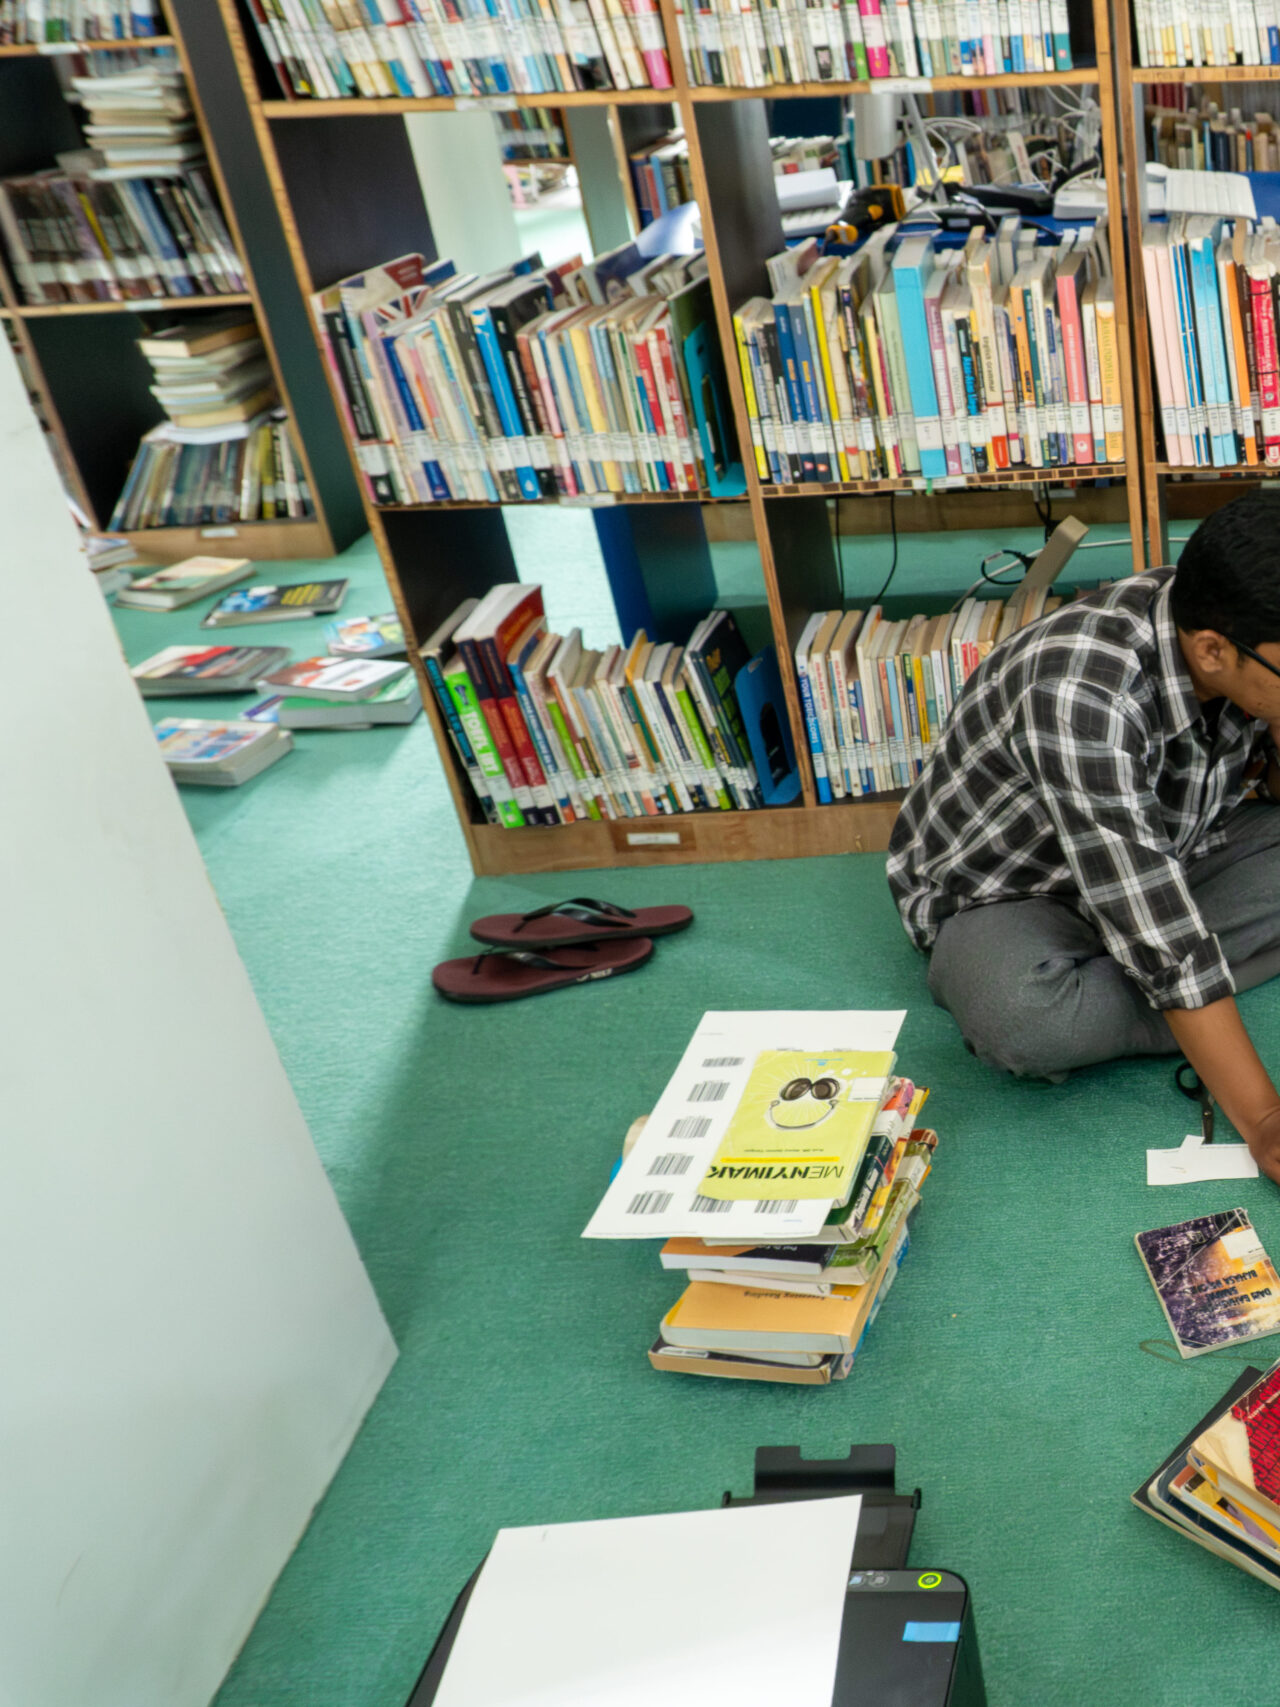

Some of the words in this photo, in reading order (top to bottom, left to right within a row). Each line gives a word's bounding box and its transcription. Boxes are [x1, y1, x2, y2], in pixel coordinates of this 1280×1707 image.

[981, 336, 992, 361] English
[985, 361, 996, 393] Grammar
[466, 710, 489, 752] TOEFL
[707, 1166, 845, 1179] MENYIMAK
[1222, 1269, 1258, 1287] BAHASA
